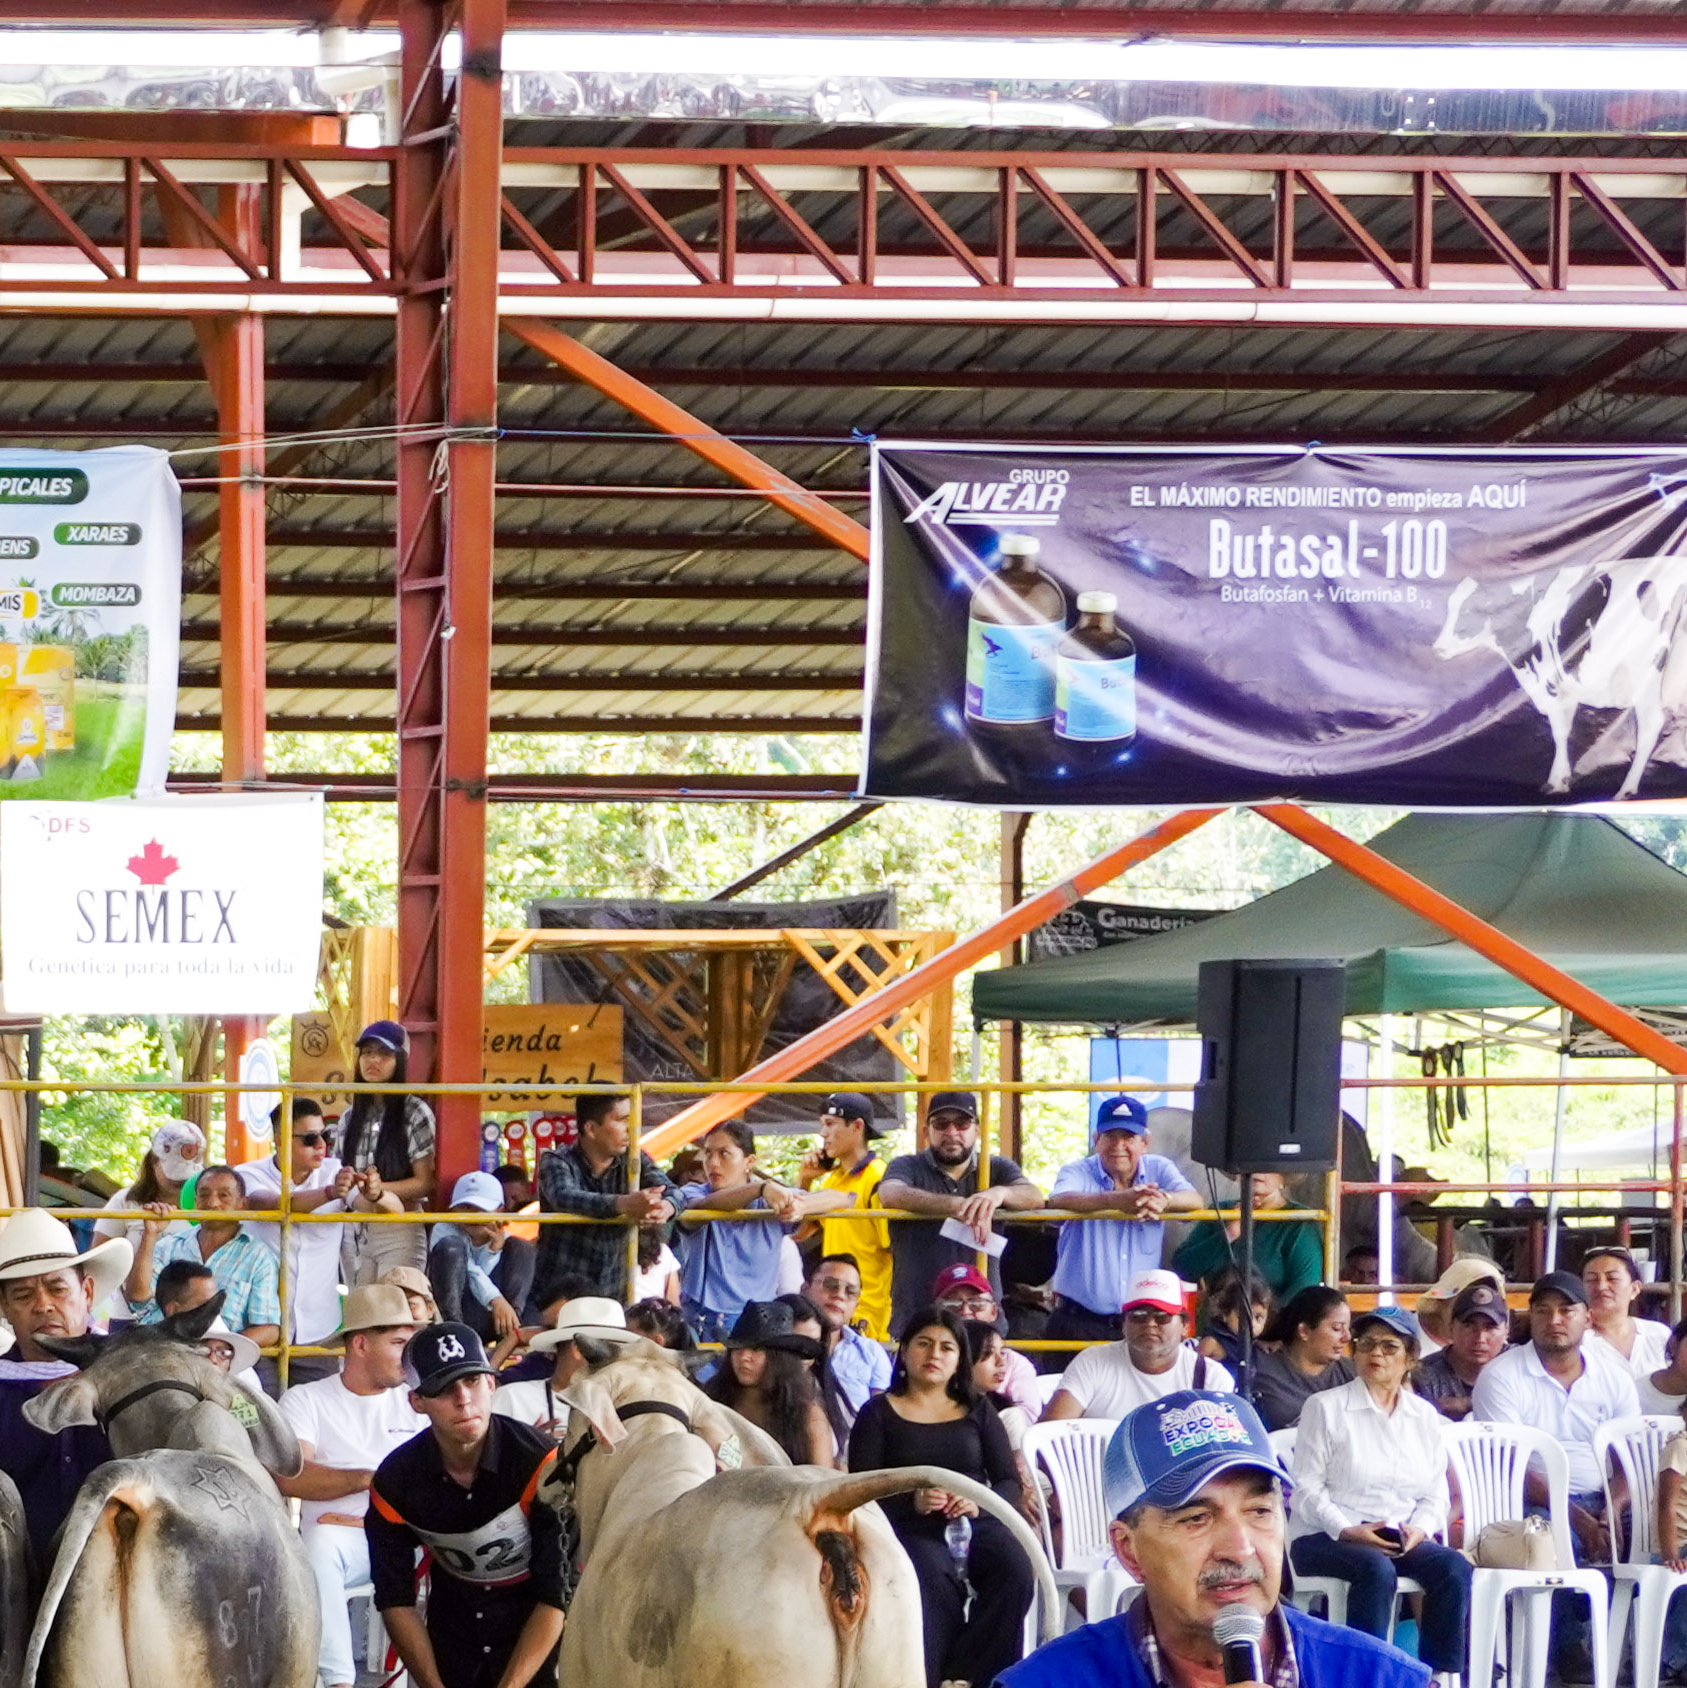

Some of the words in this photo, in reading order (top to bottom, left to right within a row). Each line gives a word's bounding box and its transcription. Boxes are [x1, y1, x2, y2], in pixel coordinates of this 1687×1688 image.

[1009, 469, 1071, 485] GRUPO
[903, 481, 1067, 525] ALVEAR
[1130, 486, 1155, 508] EL
[1160, 481, 1242, 508] MÁXIMO
[1245, 487, 1383, 509] RENDIMIENTO
[1385, 488, 1463, 513] empieza
[1467, 479, 1528, 509] AQUÍ
[66, 525, 130, 542] XARAES
[1208, 518, 1448, 580] Butasal-100
[58, 586, 137, 602] MOMBAZA
[1221, 585, 1310, 604] Butafosfan
[1313, 588, 1325, 602] +
[1329, 585, 1403, 604] Vitamina
[48, 817, 92, 834] DFS
[76, 888, 239, 944] SEMEX
[28, 957, 118, 976] Genética
[124, 960, 171, 979] para
[177, 957, 221, 976] toda
[227, 957, 246, 975] la
[252, 957, 295, 976] vida
[651, 1063, 695, 1080] ALTA
